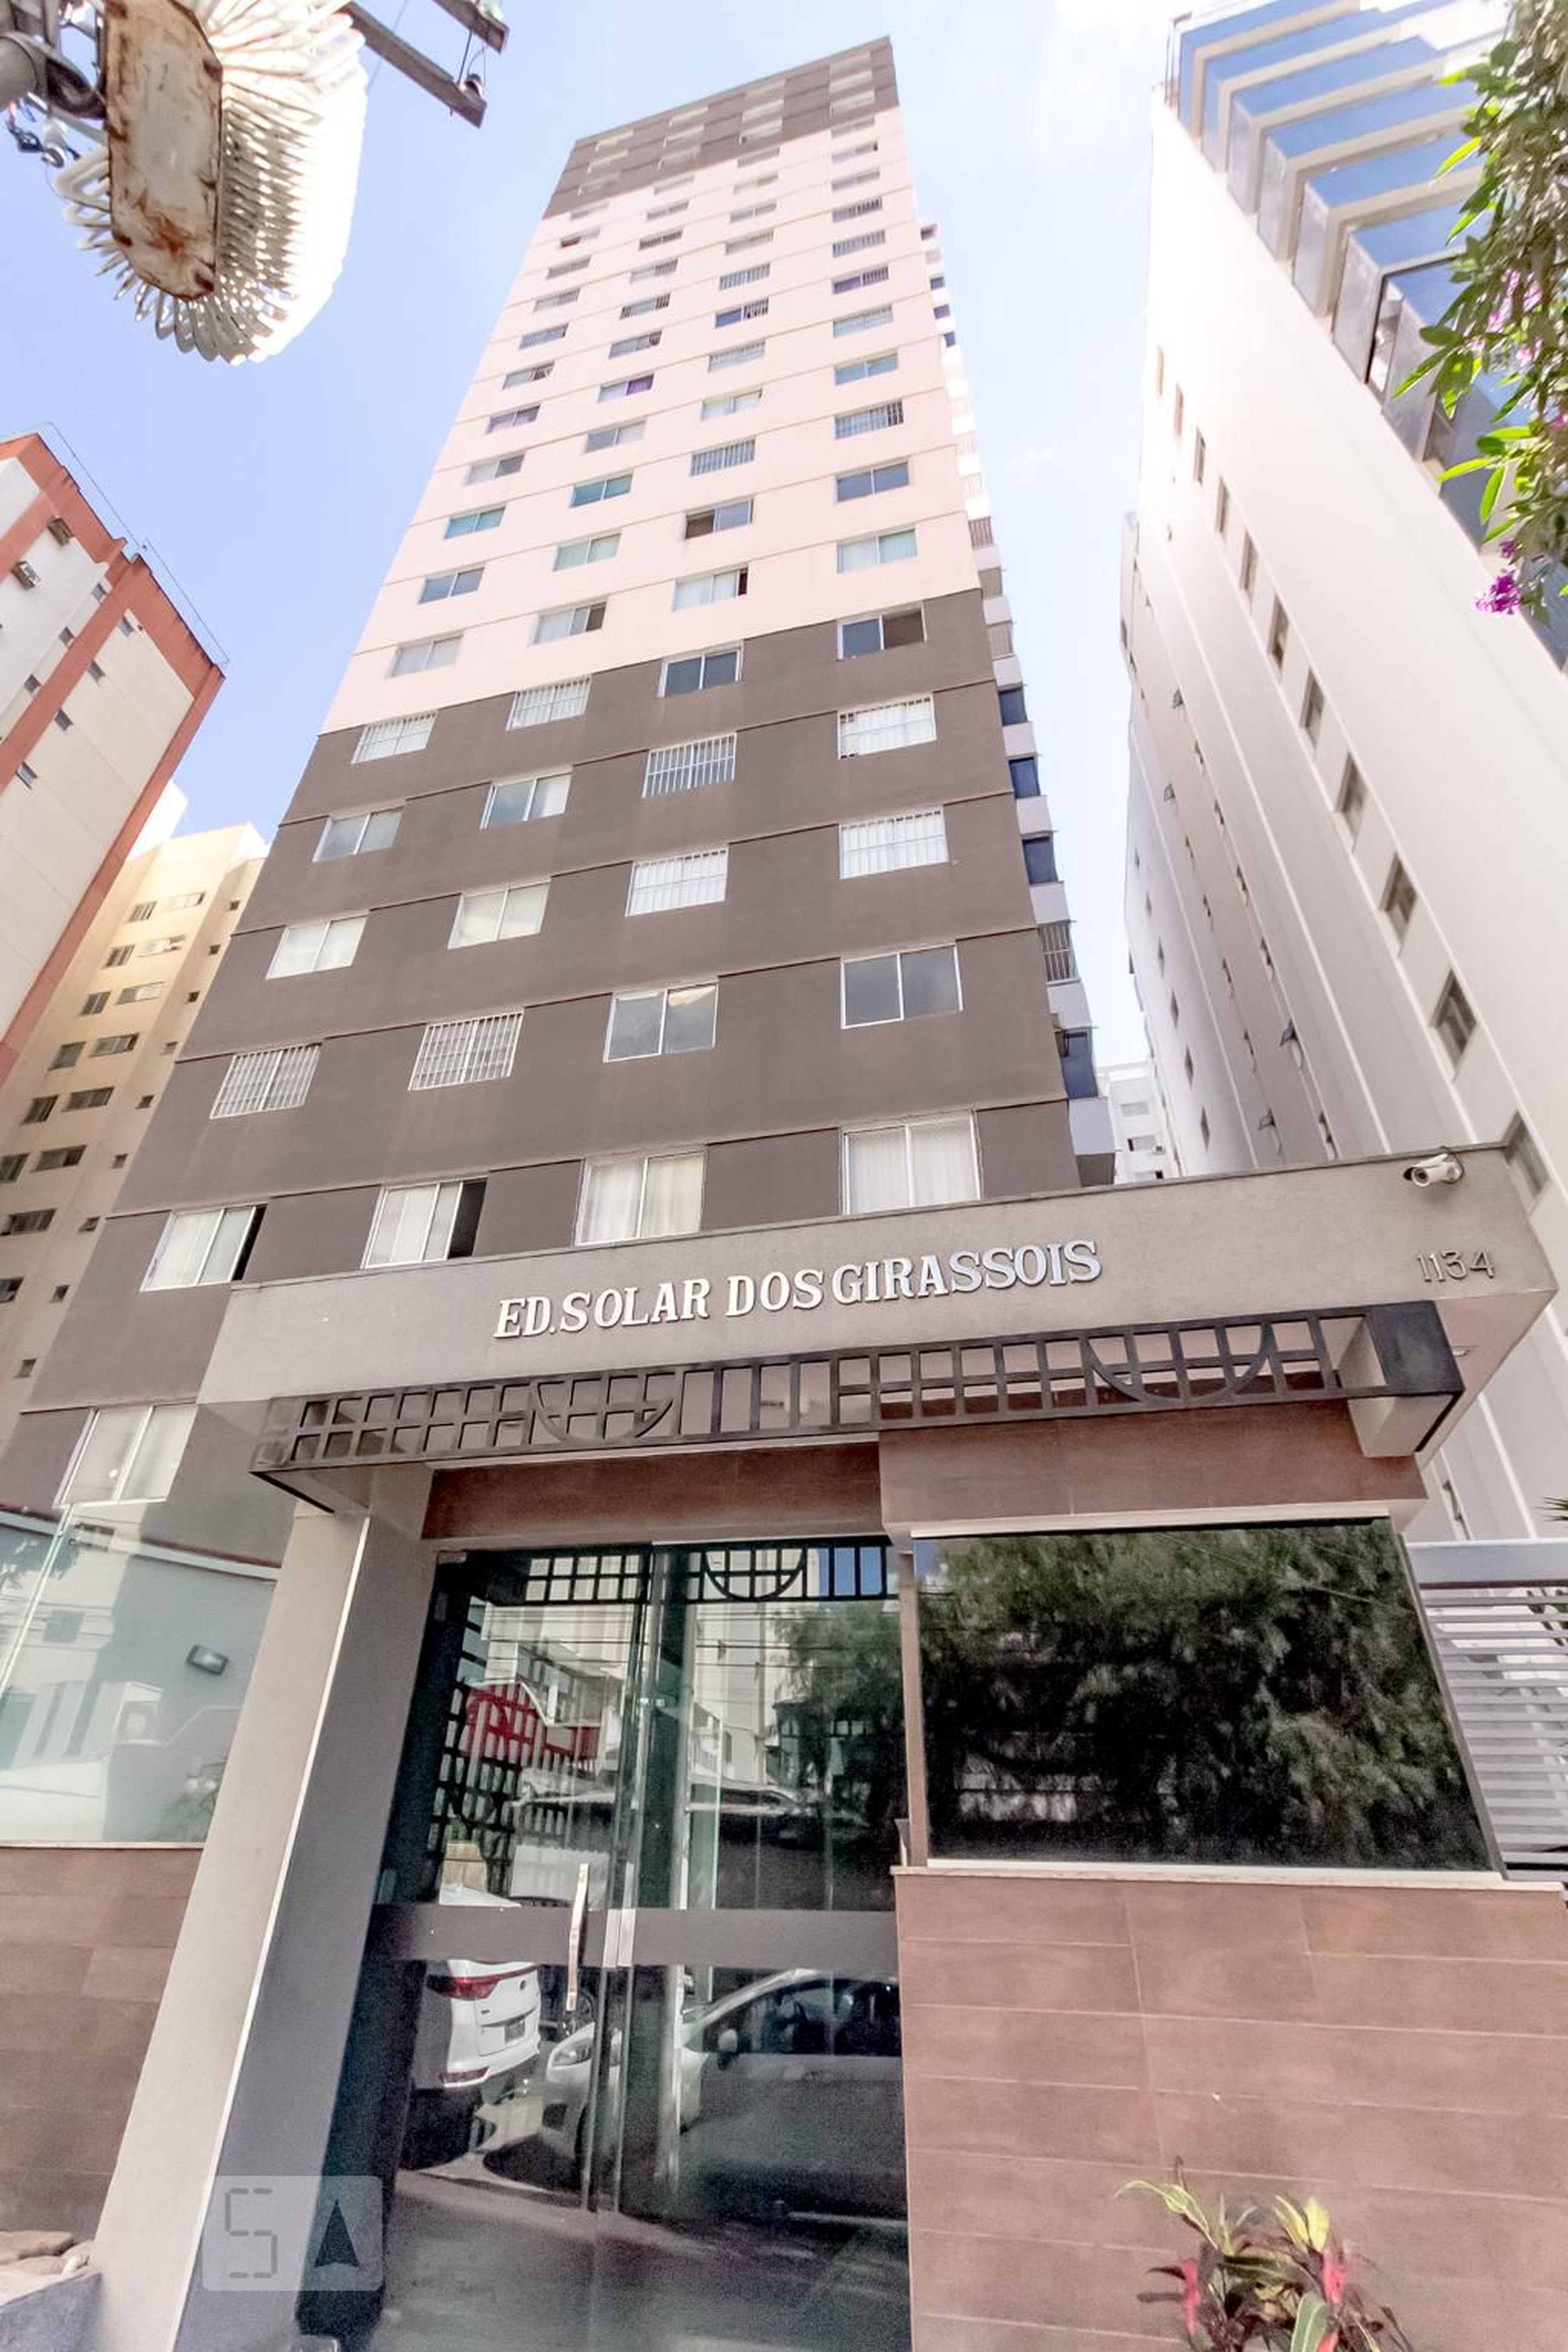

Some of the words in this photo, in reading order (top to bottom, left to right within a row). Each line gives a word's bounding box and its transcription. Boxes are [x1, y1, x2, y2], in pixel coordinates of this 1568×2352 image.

[725, 1268, 824, 1317] DOS
[832, 1240, 1102, 1305] GIRASSOIS
[1417, 1250, 1494, 1283] 1134
